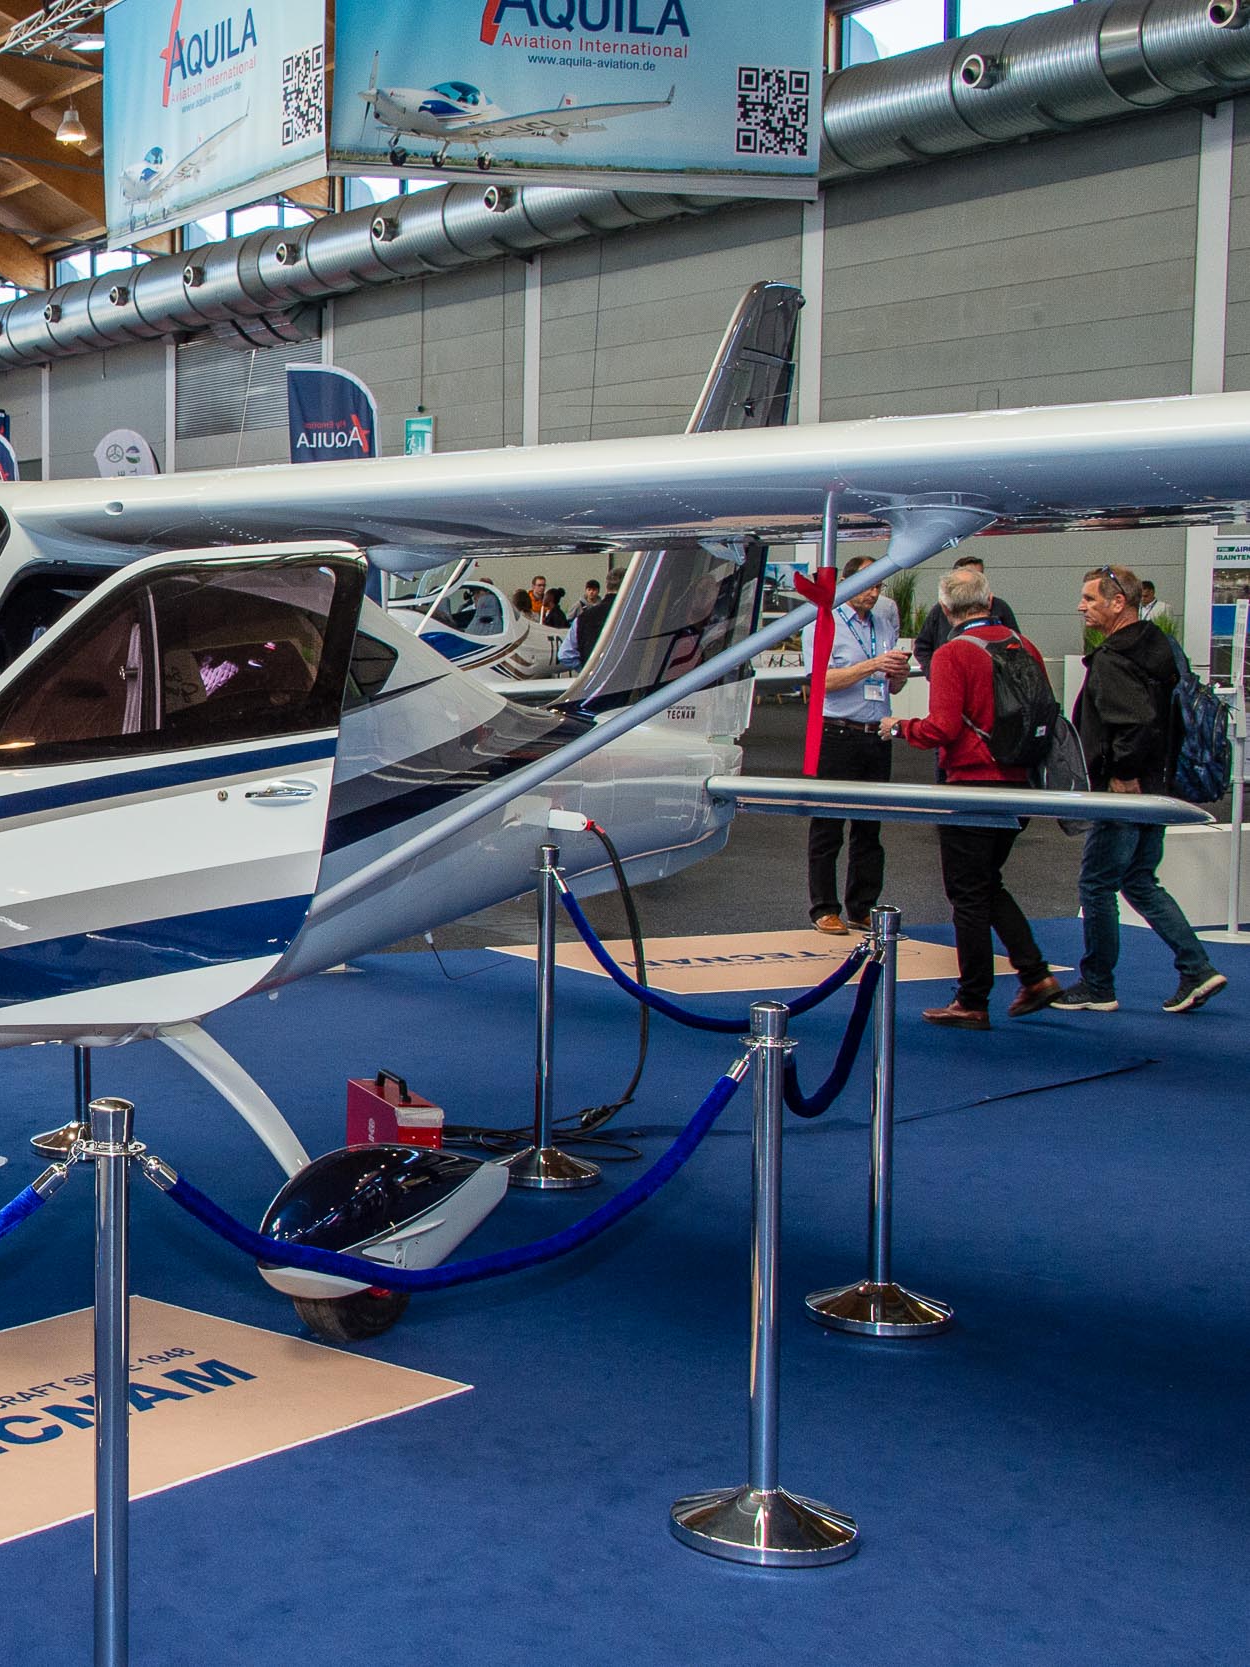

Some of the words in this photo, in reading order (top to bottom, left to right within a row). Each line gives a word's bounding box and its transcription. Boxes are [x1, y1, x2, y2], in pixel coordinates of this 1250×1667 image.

[168, 7, 257, 87] AQUILA
[502, 32, 572, 51] Aviation
[579, 37, 689, 59] International
[171, 82, 201, 103] Aviation
[204, 55, 257, 89] International
[527, 54, 656, 72] www.aquila-aviation.de
[667, 710, 696, 720] TECNAM
[63, 1364, 144, 1386] SIE
[138, 1347, 196, 1365] 1948
